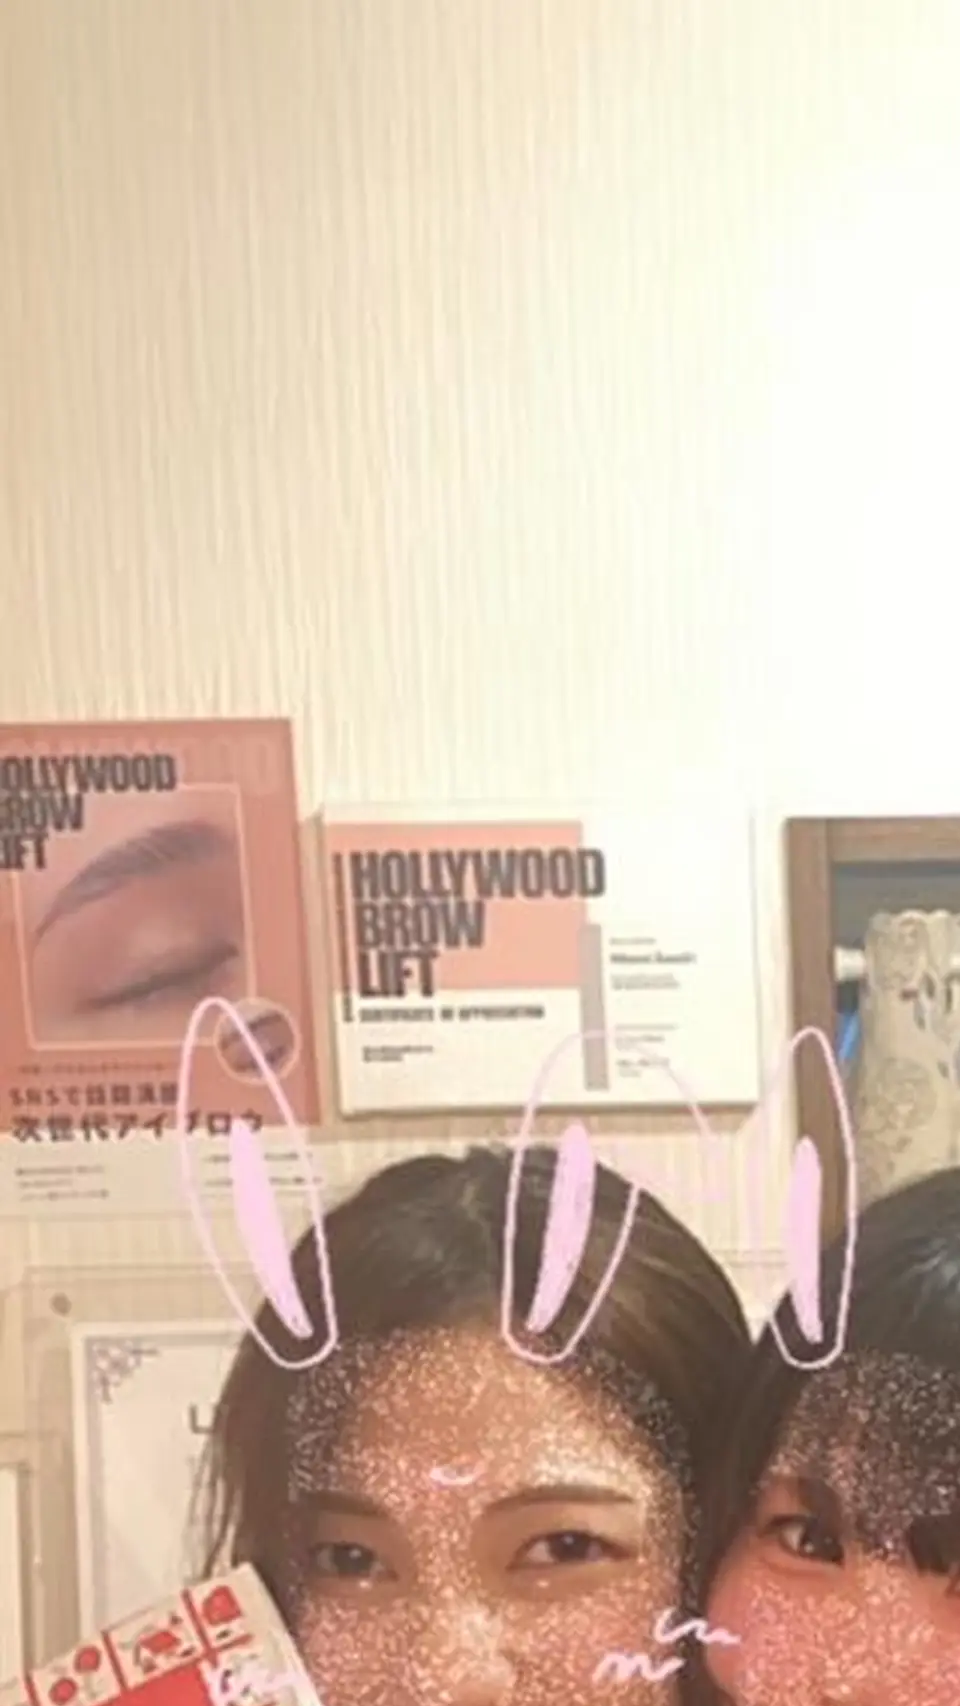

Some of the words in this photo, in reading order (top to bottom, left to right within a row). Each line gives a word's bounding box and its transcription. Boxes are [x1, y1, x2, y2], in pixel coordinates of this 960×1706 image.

[0, 754, 177, 793] OLLYWOOD
[351, 847, 606, 900] HOLLYWOOD
[355, 898, 485, 949] BROW
[357, 948, 440, 998] LIFT
